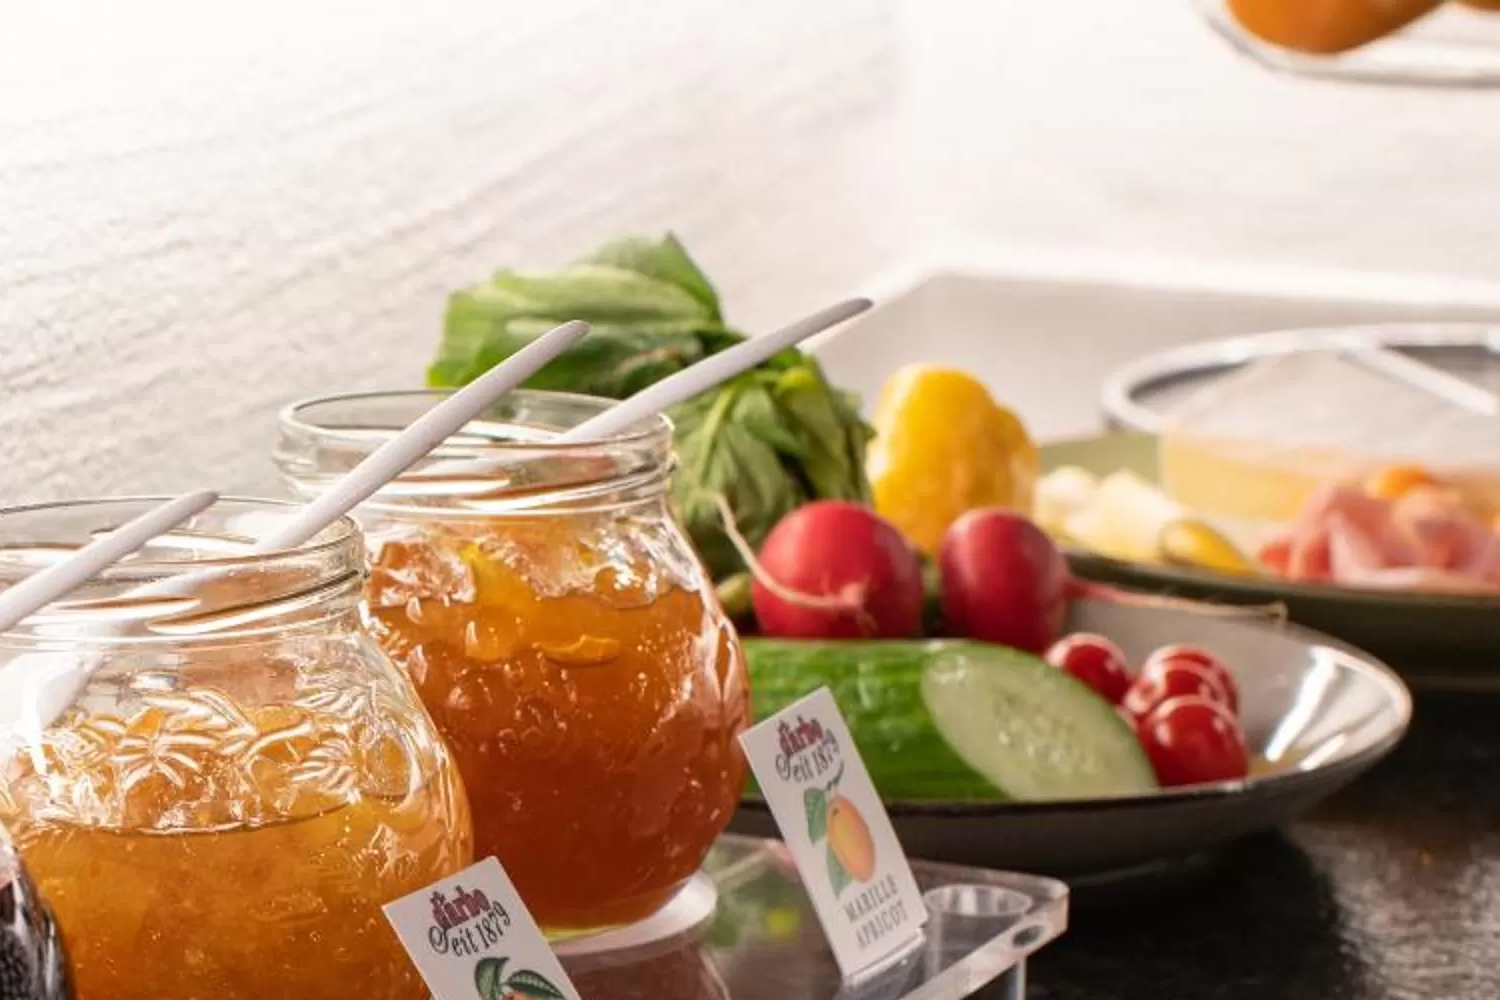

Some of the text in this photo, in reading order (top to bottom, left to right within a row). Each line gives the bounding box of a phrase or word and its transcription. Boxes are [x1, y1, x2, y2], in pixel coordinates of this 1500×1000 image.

[428, 900, 511, 957] Seit 1879
[855, 899, 908, 952] APRICOT
